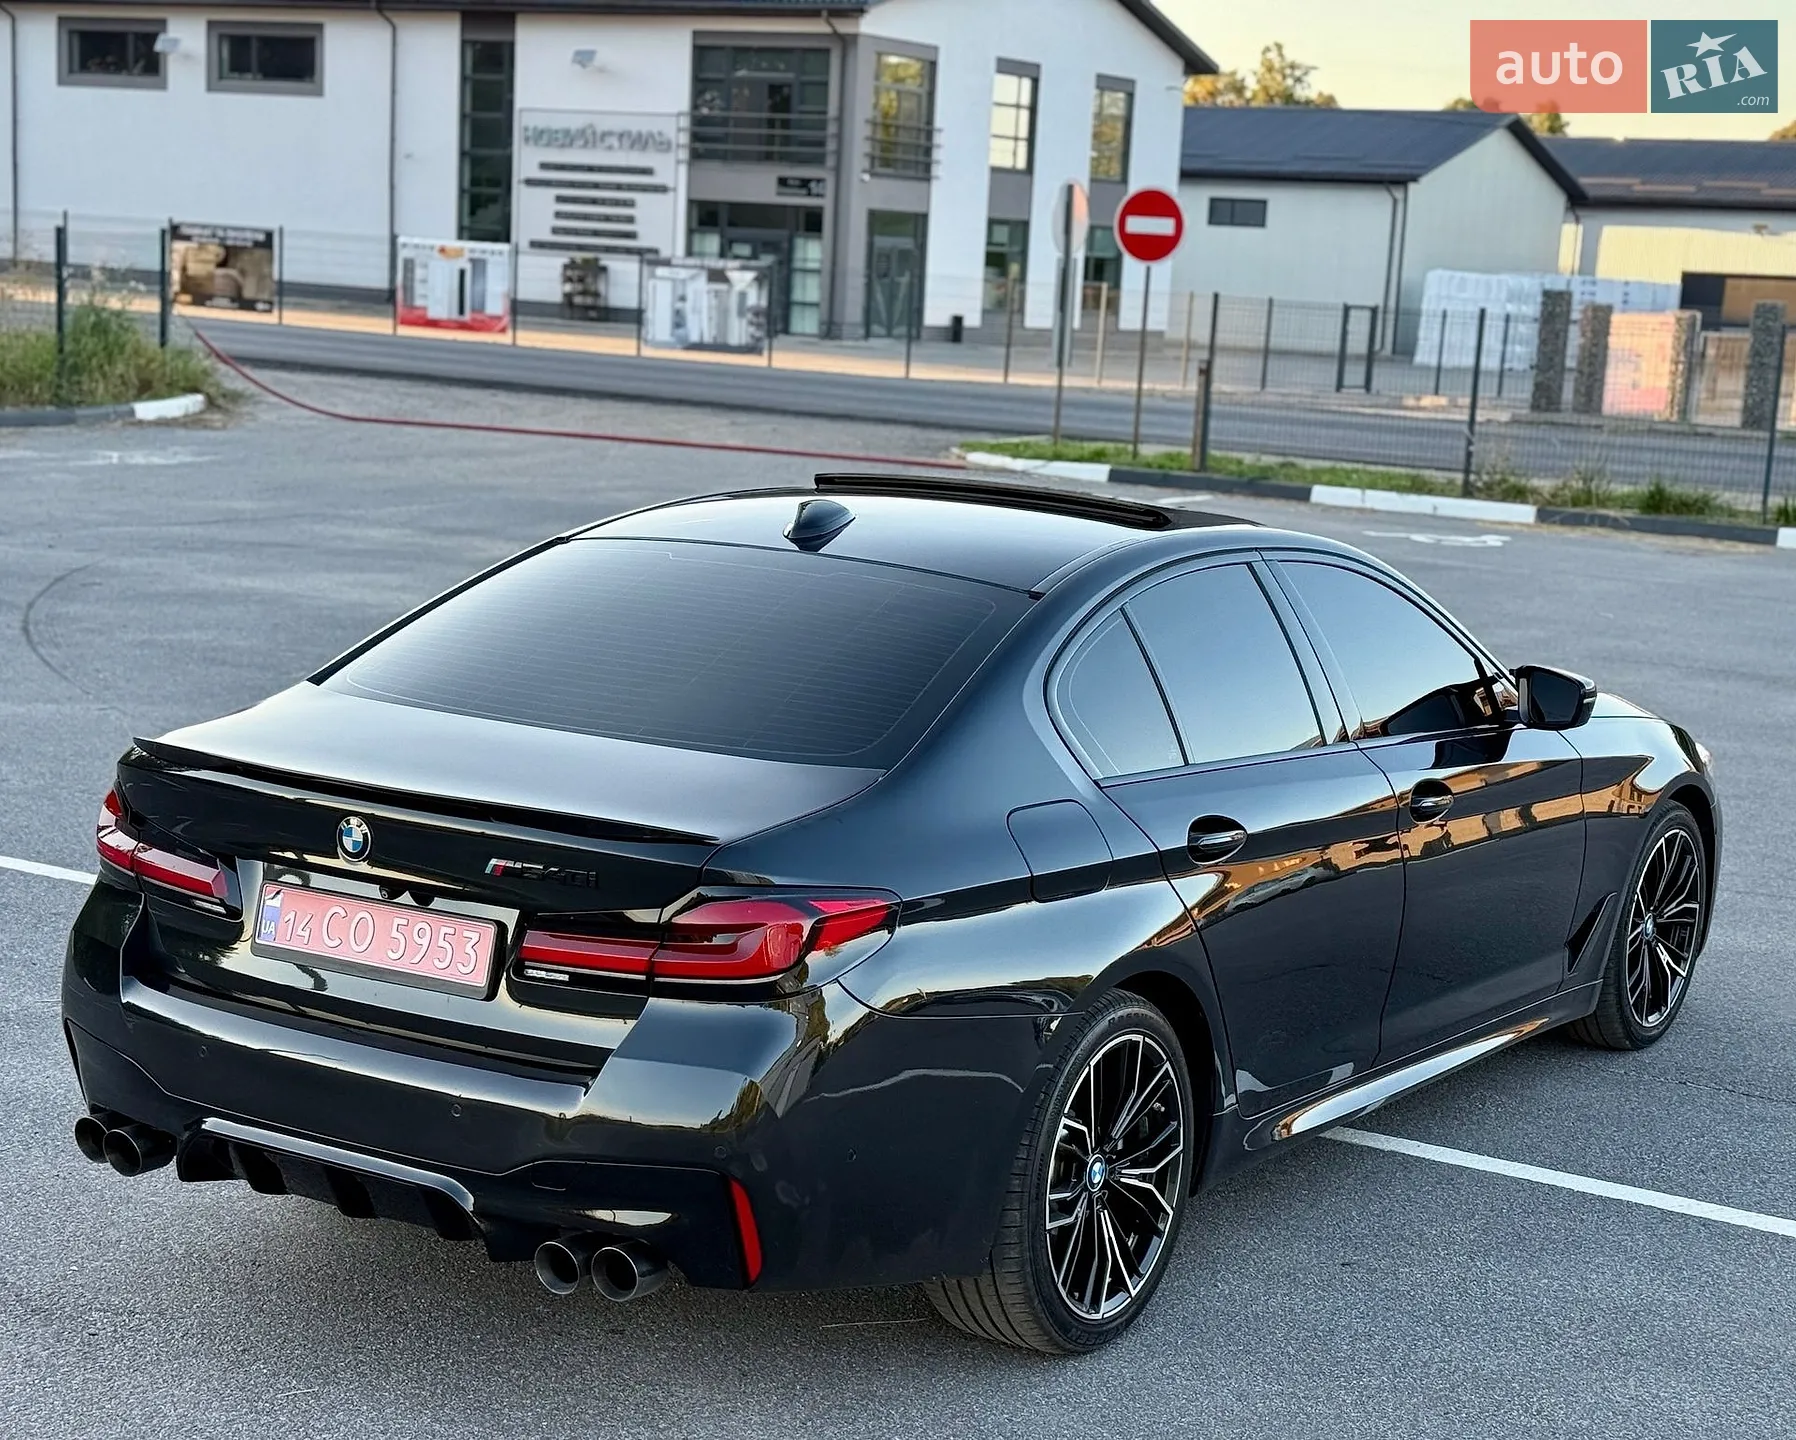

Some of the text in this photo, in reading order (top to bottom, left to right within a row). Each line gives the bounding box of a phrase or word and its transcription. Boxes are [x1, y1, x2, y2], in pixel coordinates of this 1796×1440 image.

[261, 919, 276, 935] UA
[283, 905, 482, 976] 14 CO 5953
